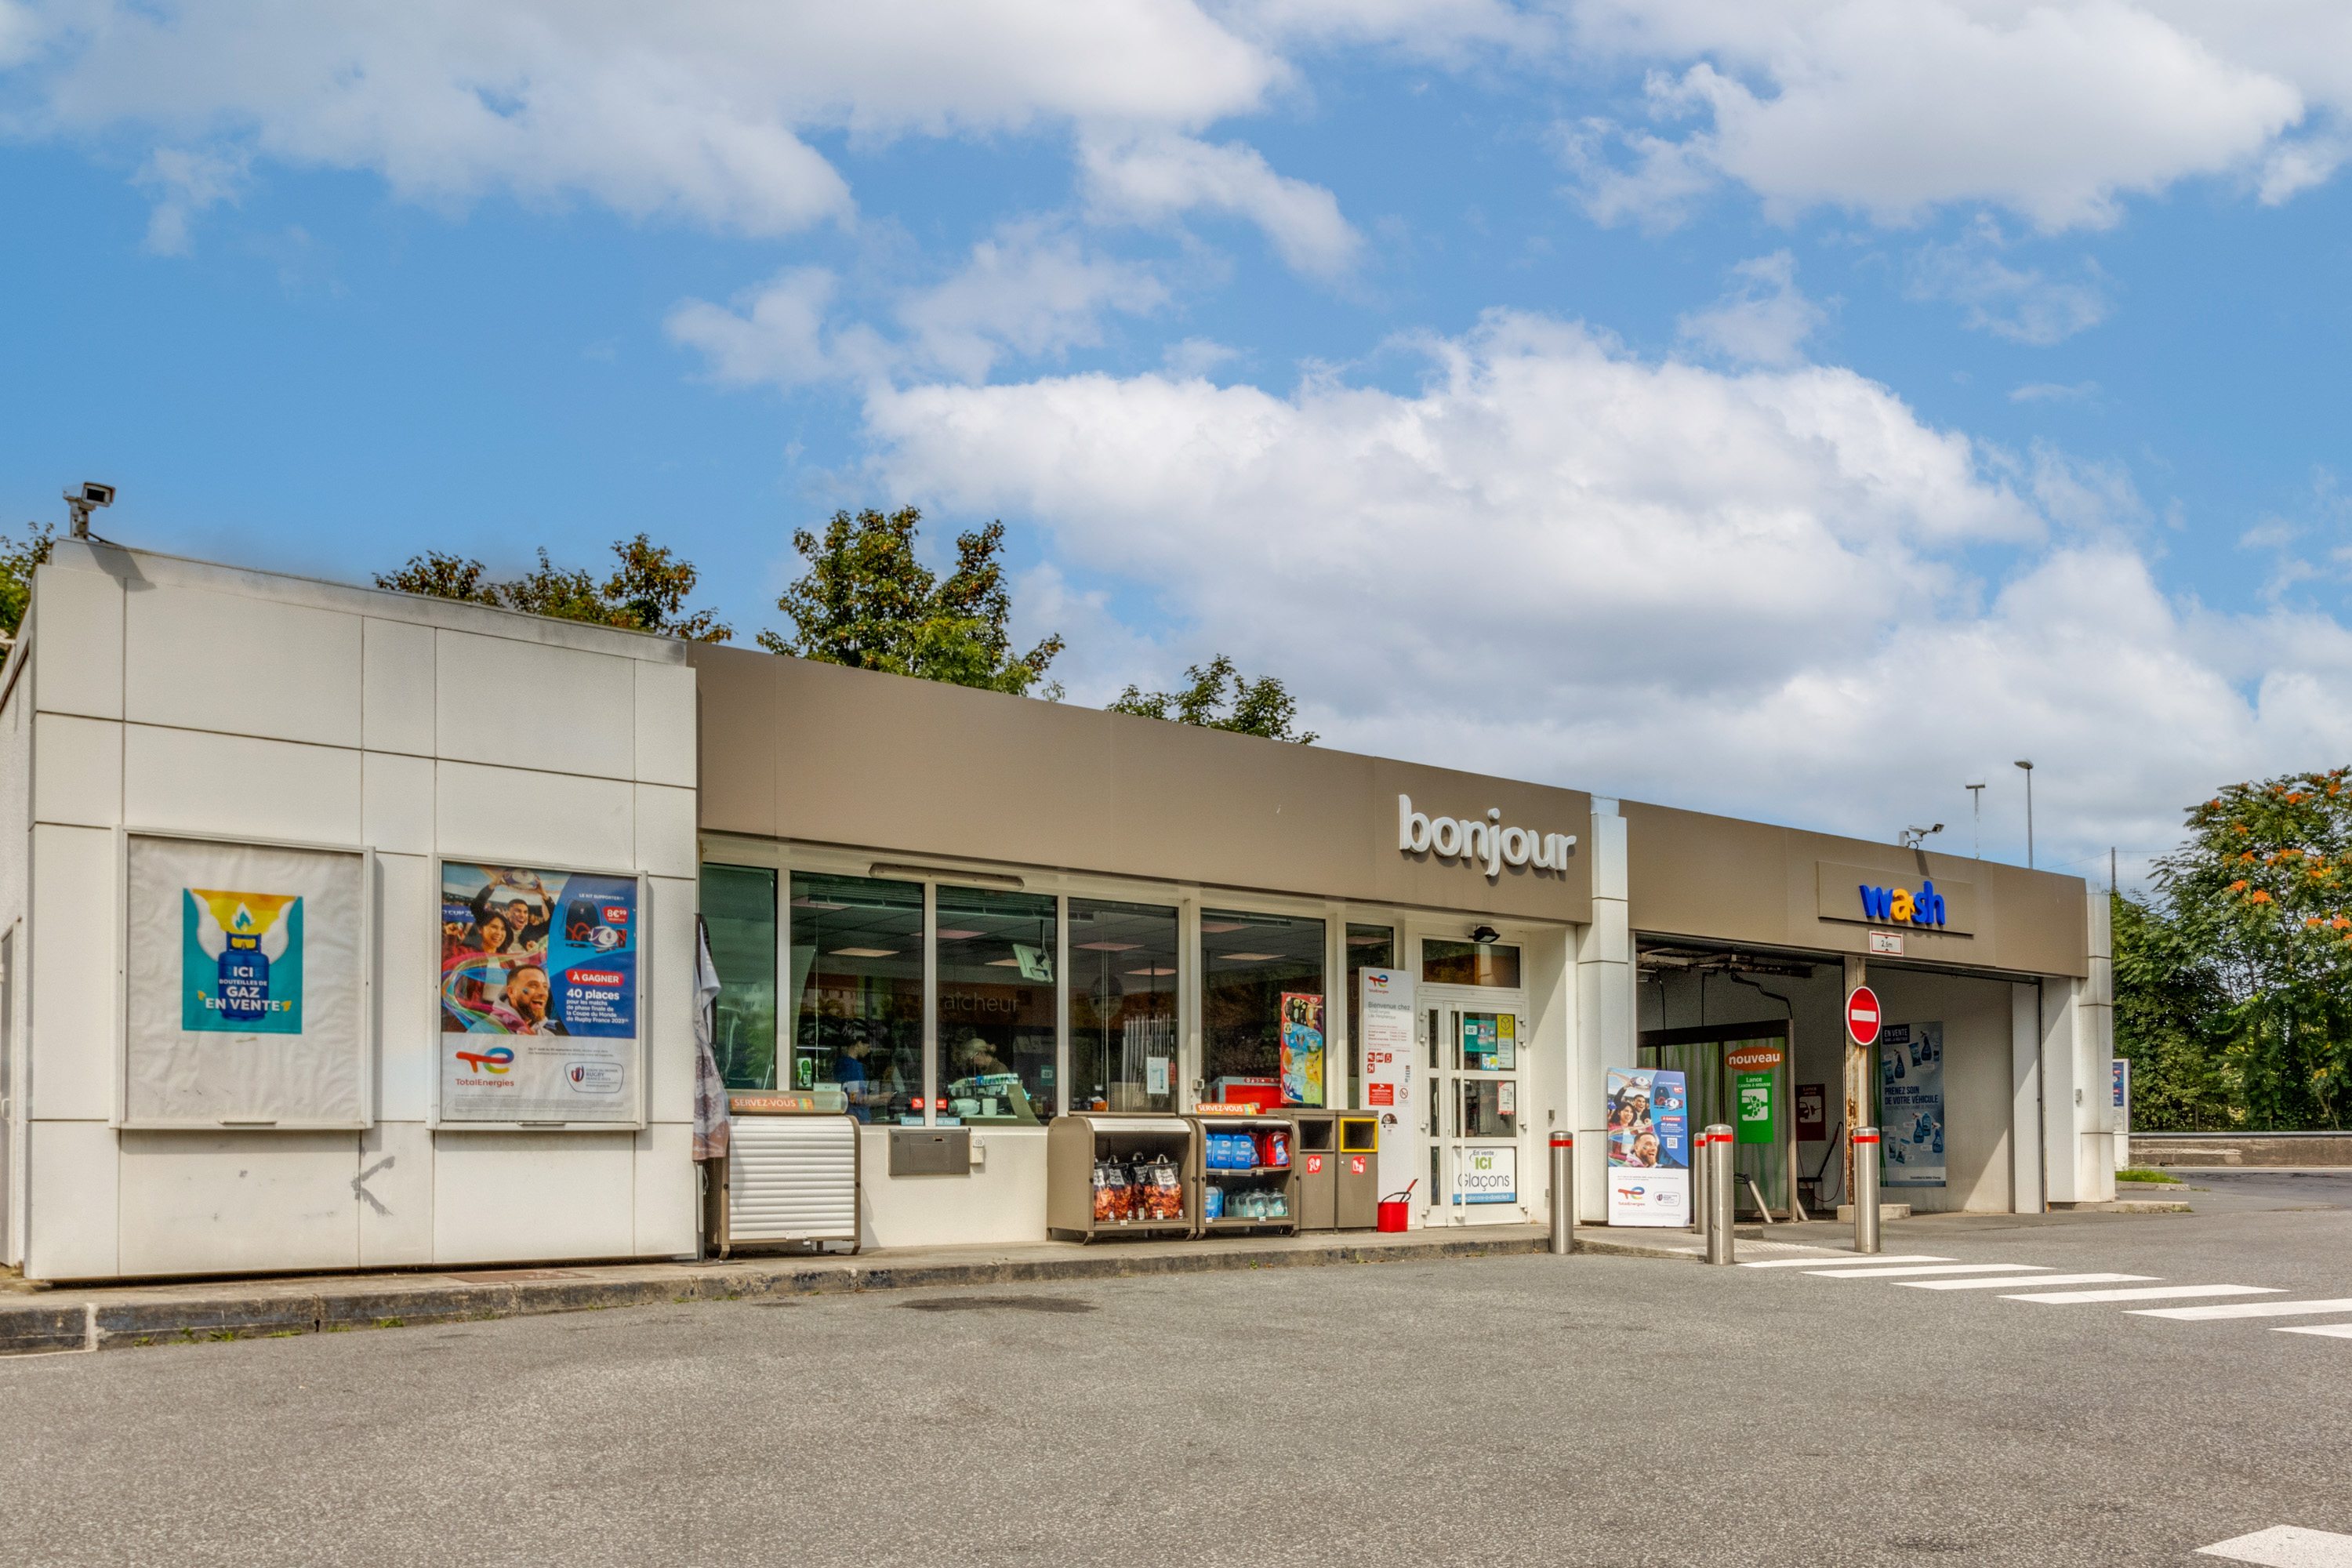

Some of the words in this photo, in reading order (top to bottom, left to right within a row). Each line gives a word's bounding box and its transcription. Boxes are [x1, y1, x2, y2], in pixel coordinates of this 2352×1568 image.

[1399, 794, 1577, 877] bonjour
[1859, 880, 1946, 925] wash
[233, 966, 254, 978] ICI
[572, 971, 580, 982] À
[582, 974, 619, 983] GAGNER
[226, 985, 260, 998] GAZ
[566, 988, 583, 998] 40
[585, 989, 620, 1000] places
[205, 997, 227, 1010] EN
[230, 999, 281, 1011] VENTE
[1729, 1053, 1780, 1065] nouveau
[456, 1079, 514, 1087] TotalEnergies
[1885, 1087, 1906, 1095] PRENEZ
[1906, 1086, 1920, 1094] SOIN
[734, 1098, 796, 1107] SERVEZ-VOUS
[1885, 1096, 1892, 1105] DE
[1893, 1095, 1911, 1105] VOTRE
[1911, 1094, 1938, 1104] VÉHICULE
[1475, 1156, 1492, 1170] ICI
[1457, 1173, 1510, 1192] Glaçons
